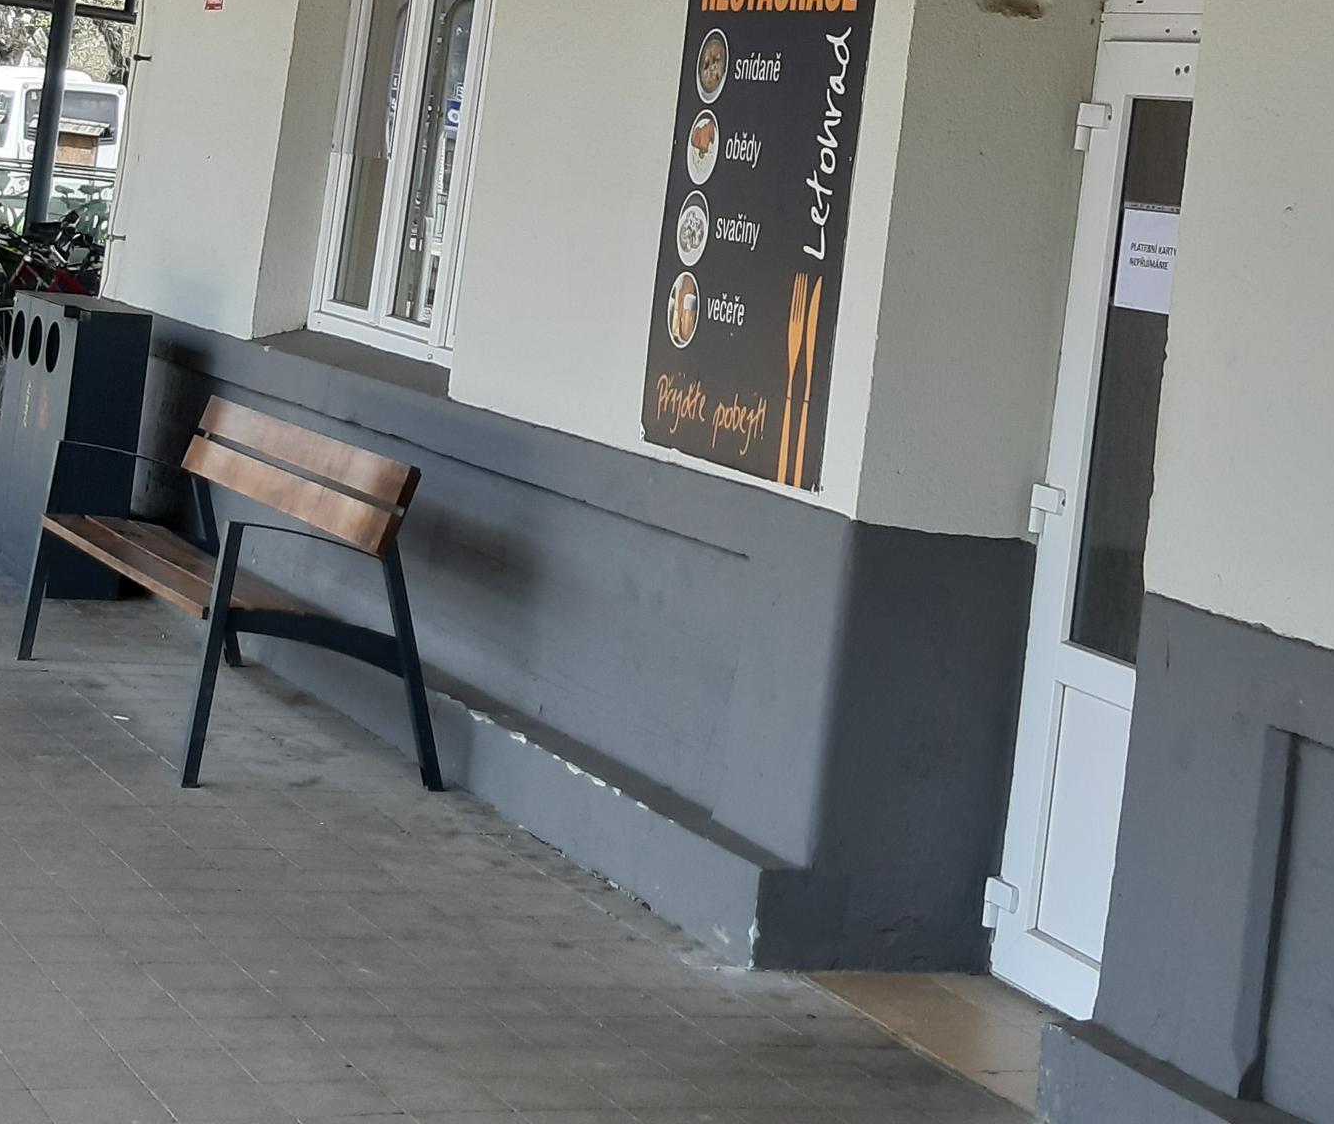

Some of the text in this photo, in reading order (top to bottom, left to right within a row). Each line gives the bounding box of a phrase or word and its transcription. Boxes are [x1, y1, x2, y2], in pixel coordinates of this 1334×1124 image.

[734, 51, 782, 82] snídaně
[725, 131, 762, 169] obědy
[802, 26, 853, 261] Letohrad
[715, 213, 761, 251] svačiny
[707, 293, 745, 326] večeře
